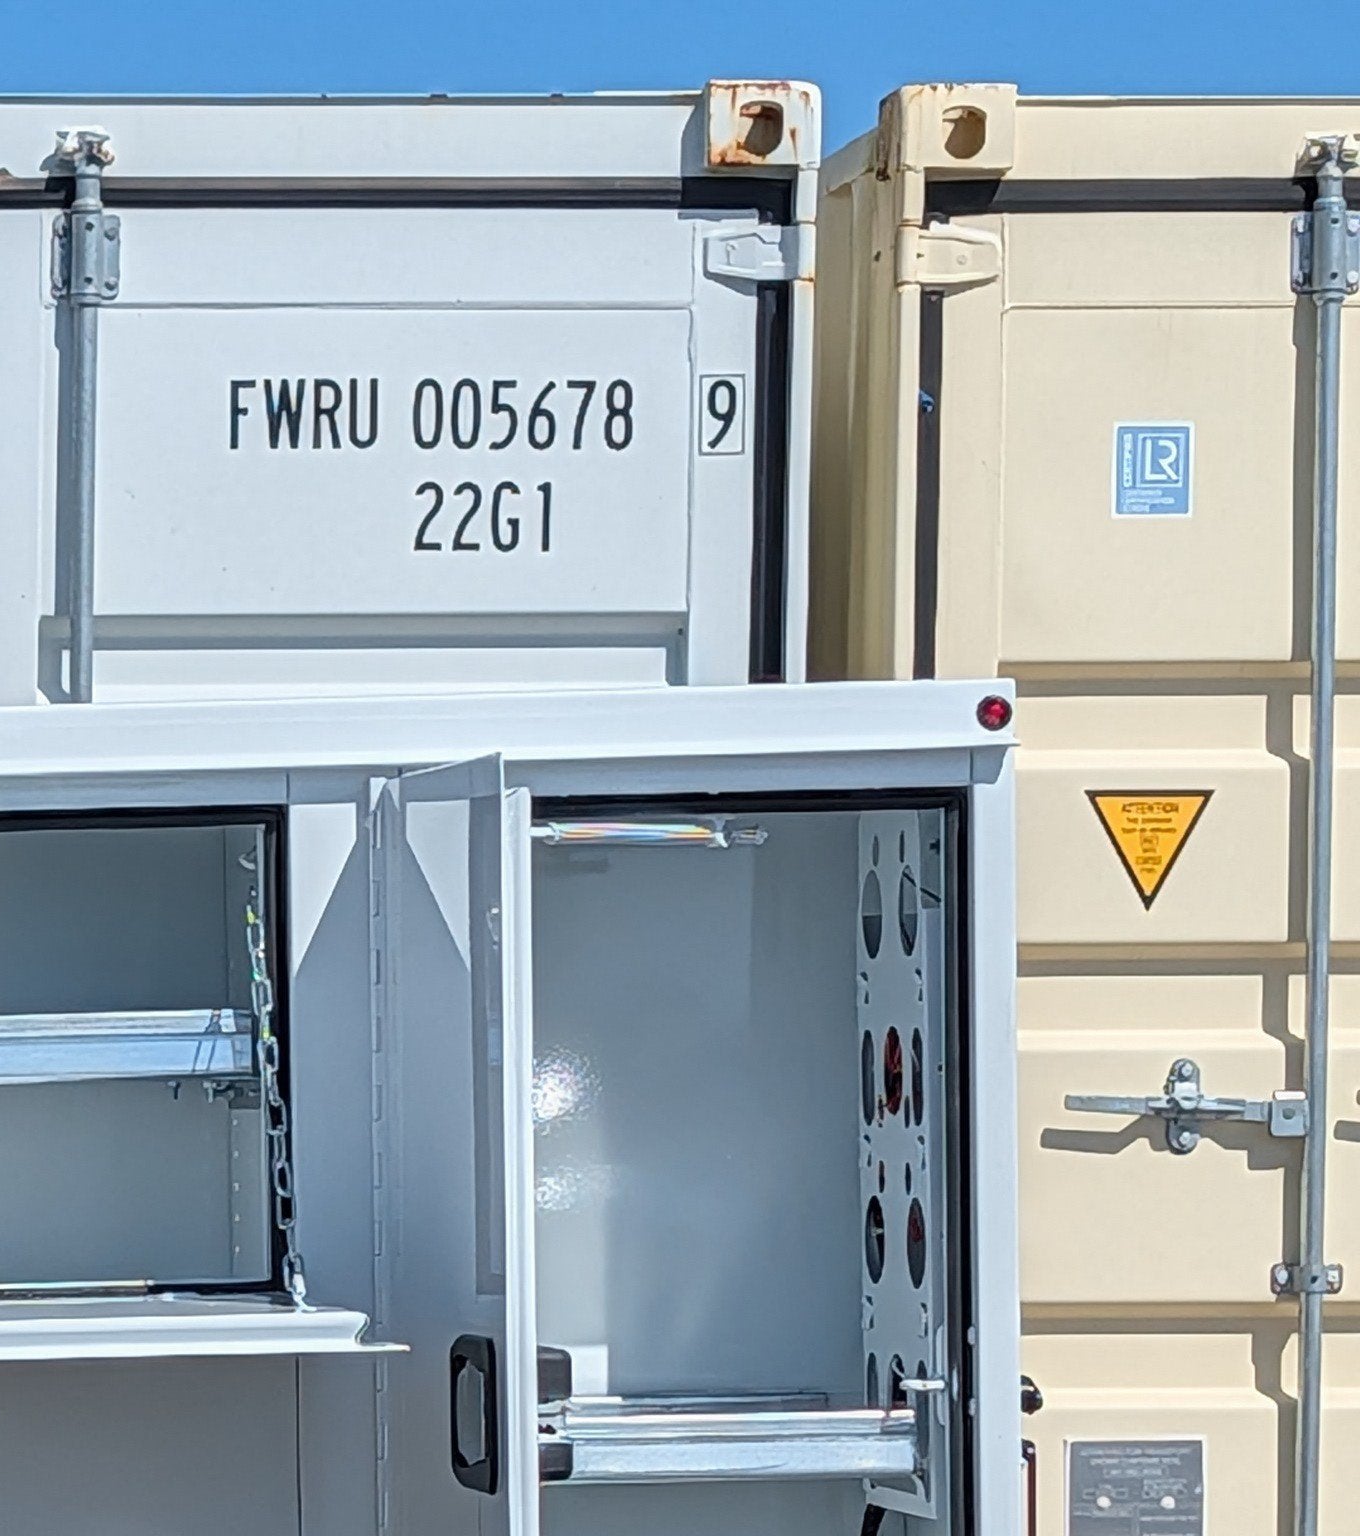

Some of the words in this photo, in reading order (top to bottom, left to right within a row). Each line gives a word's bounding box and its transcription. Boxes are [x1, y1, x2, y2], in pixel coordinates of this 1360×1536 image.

[229, 377, 379, 450] FWRU
[412, 378, 634, 451] 005678
[706, 378, 738, 450] 9
[413, 481, 553, 552] 22G1
